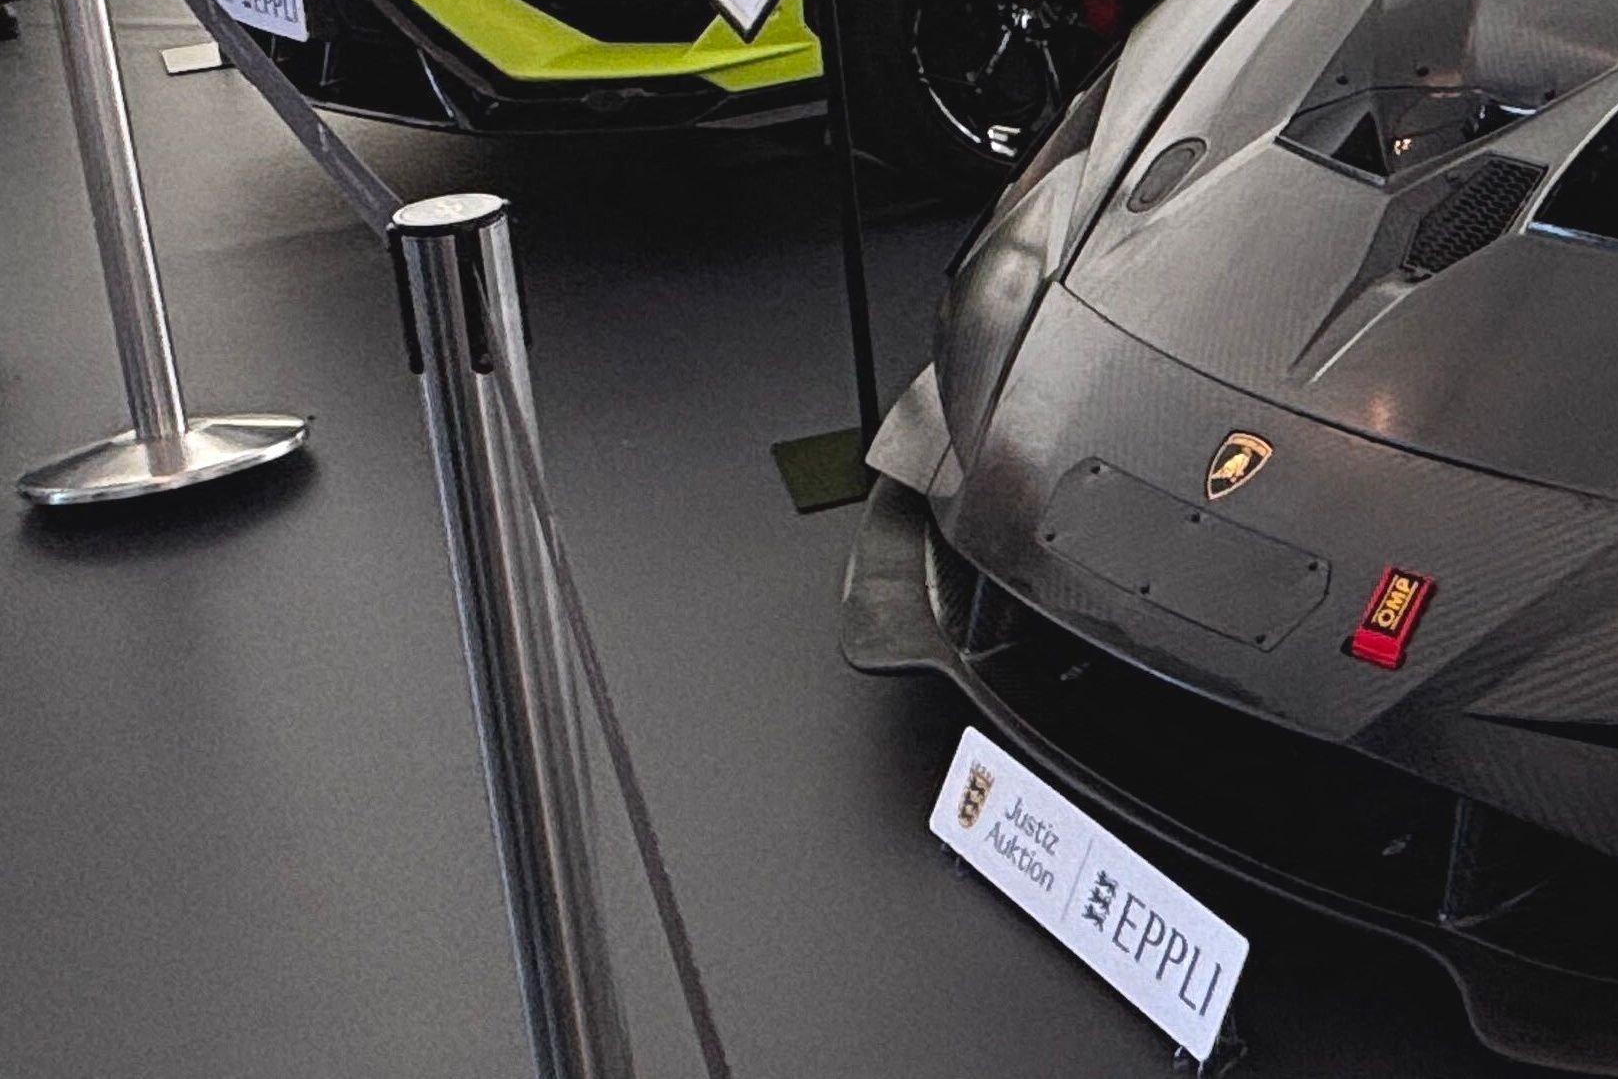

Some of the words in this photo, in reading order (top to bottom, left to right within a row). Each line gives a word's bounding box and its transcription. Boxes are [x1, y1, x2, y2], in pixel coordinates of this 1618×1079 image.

[1377, 577, 1411, 627] OMP
[984, 821, 1055, 892] Auktion
[1005, 796, 1060, 856] Justiz
[1112, 892, 1222, 1016] EPPLI
